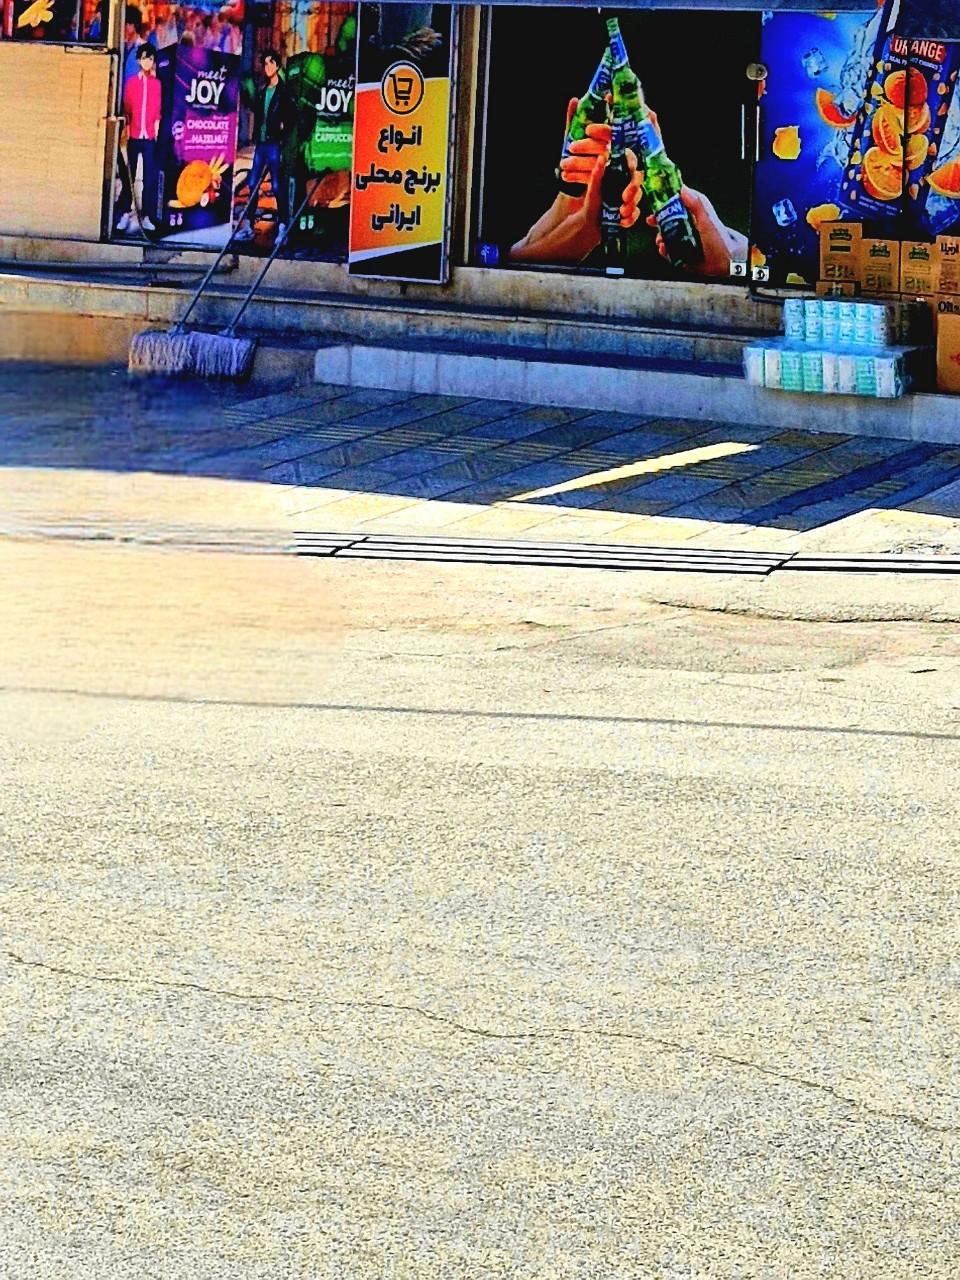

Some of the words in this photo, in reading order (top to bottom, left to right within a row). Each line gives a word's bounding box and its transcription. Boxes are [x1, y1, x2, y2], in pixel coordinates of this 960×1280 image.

[197, 65, 227, 80] meet
[327, 73, 356, 89] meet
[185, 78, 225, 105] JOY
[315, 86, 353, 113] JOY
[377, 124, 422, 153] انواع
[355, 163, 402, 190] محلی
[404, 165, 441, 195] برنج
[371, 203, 421, 231] ایرانی
